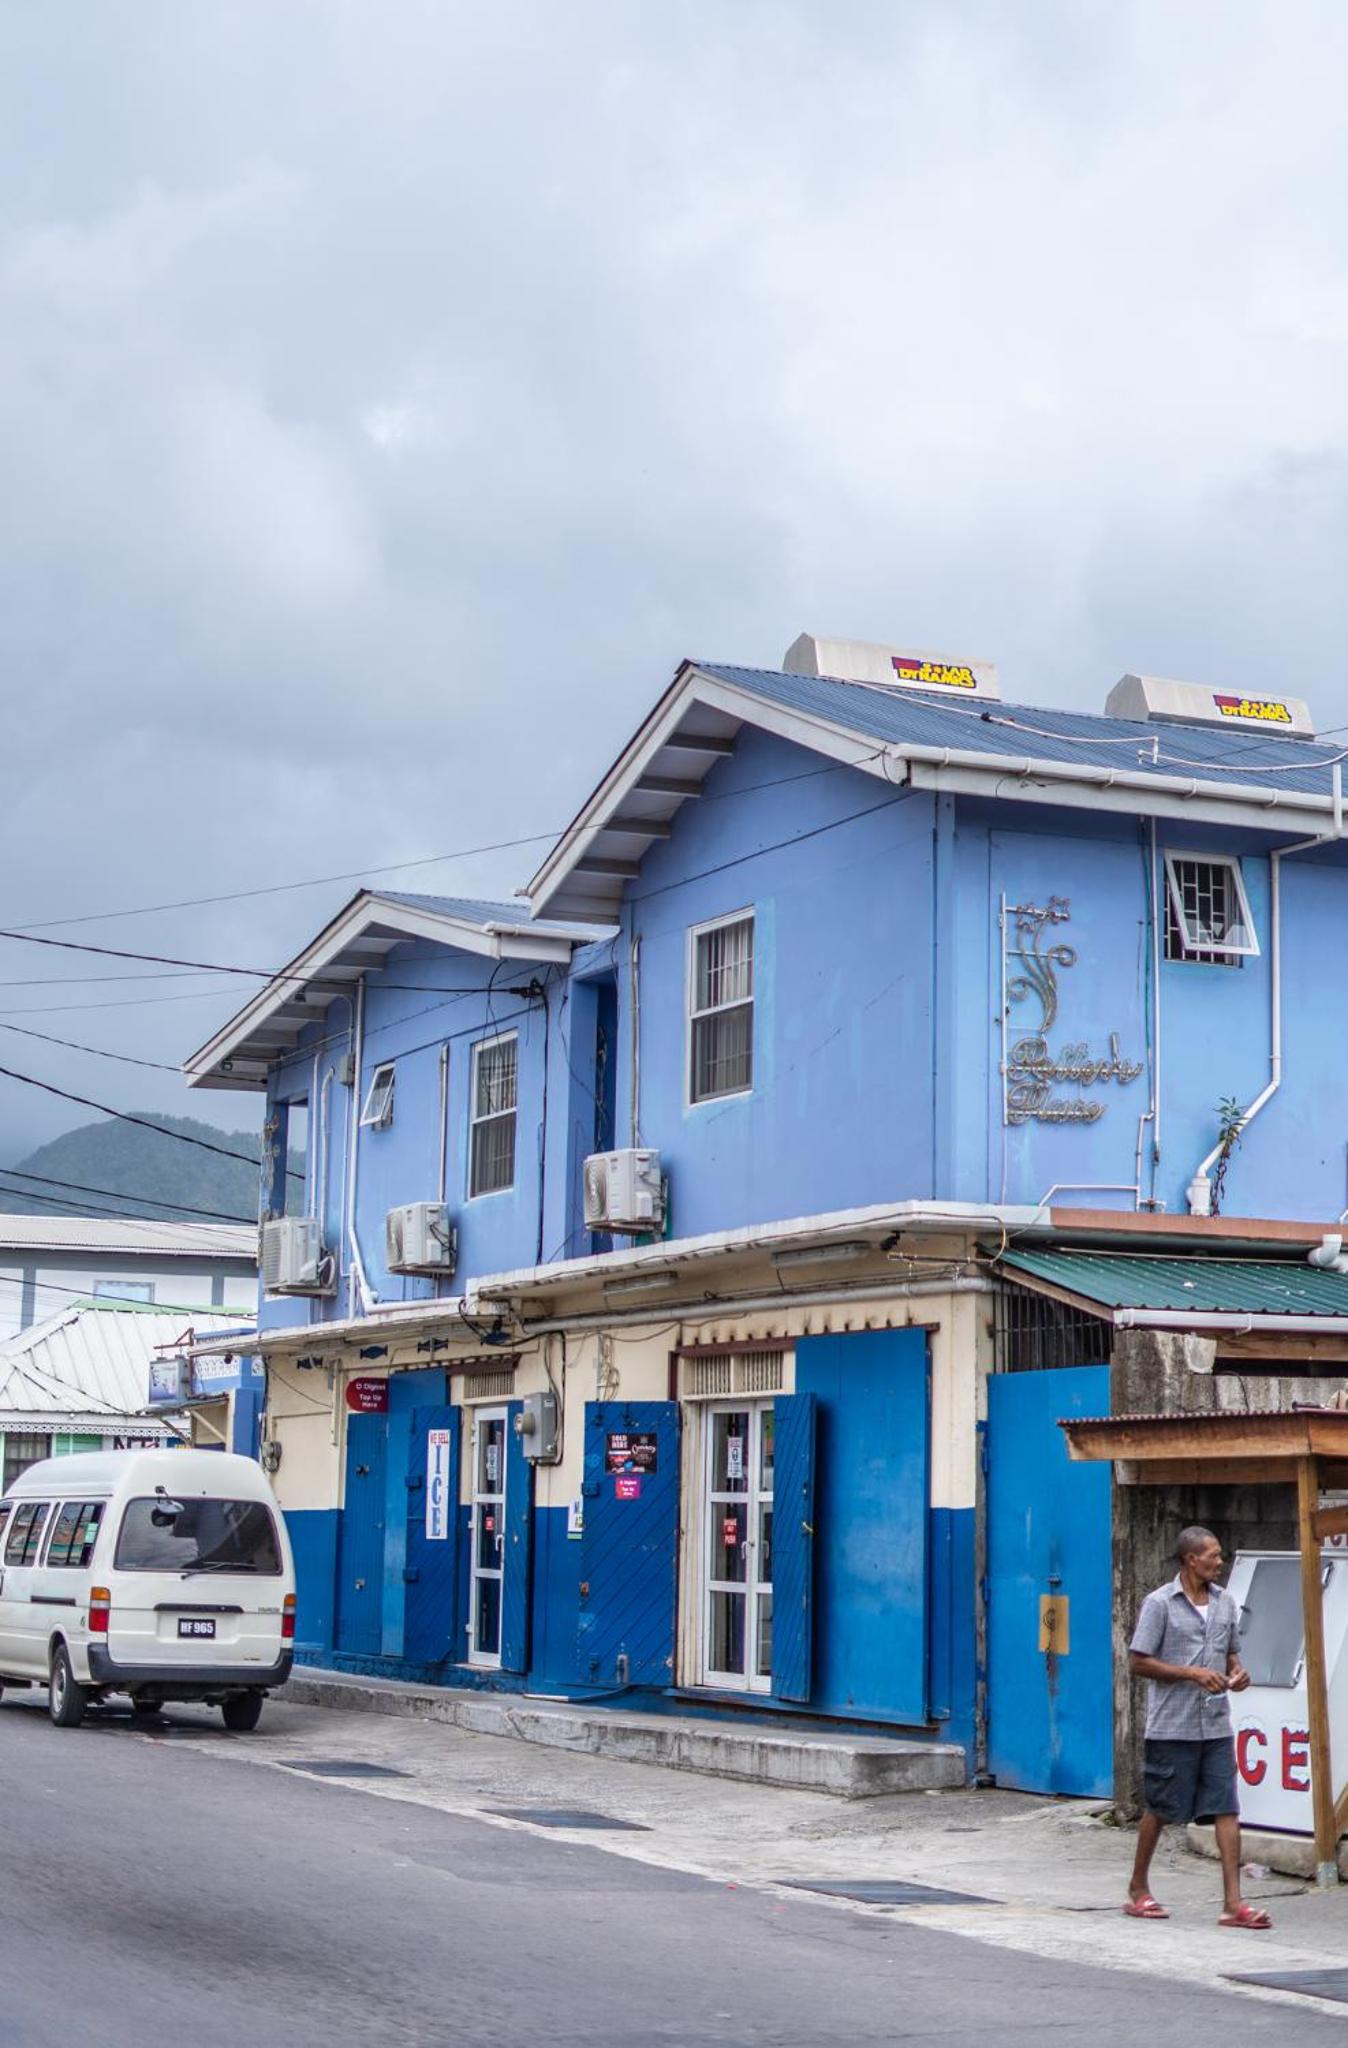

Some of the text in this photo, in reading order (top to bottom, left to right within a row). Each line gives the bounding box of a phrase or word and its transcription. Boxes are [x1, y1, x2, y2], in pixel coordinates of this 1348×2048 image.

[431, 1444, 442, 1537] ICE
[193, 1622, 214, 1634] 965
[1236, 1724, 1310, 1793] CE
